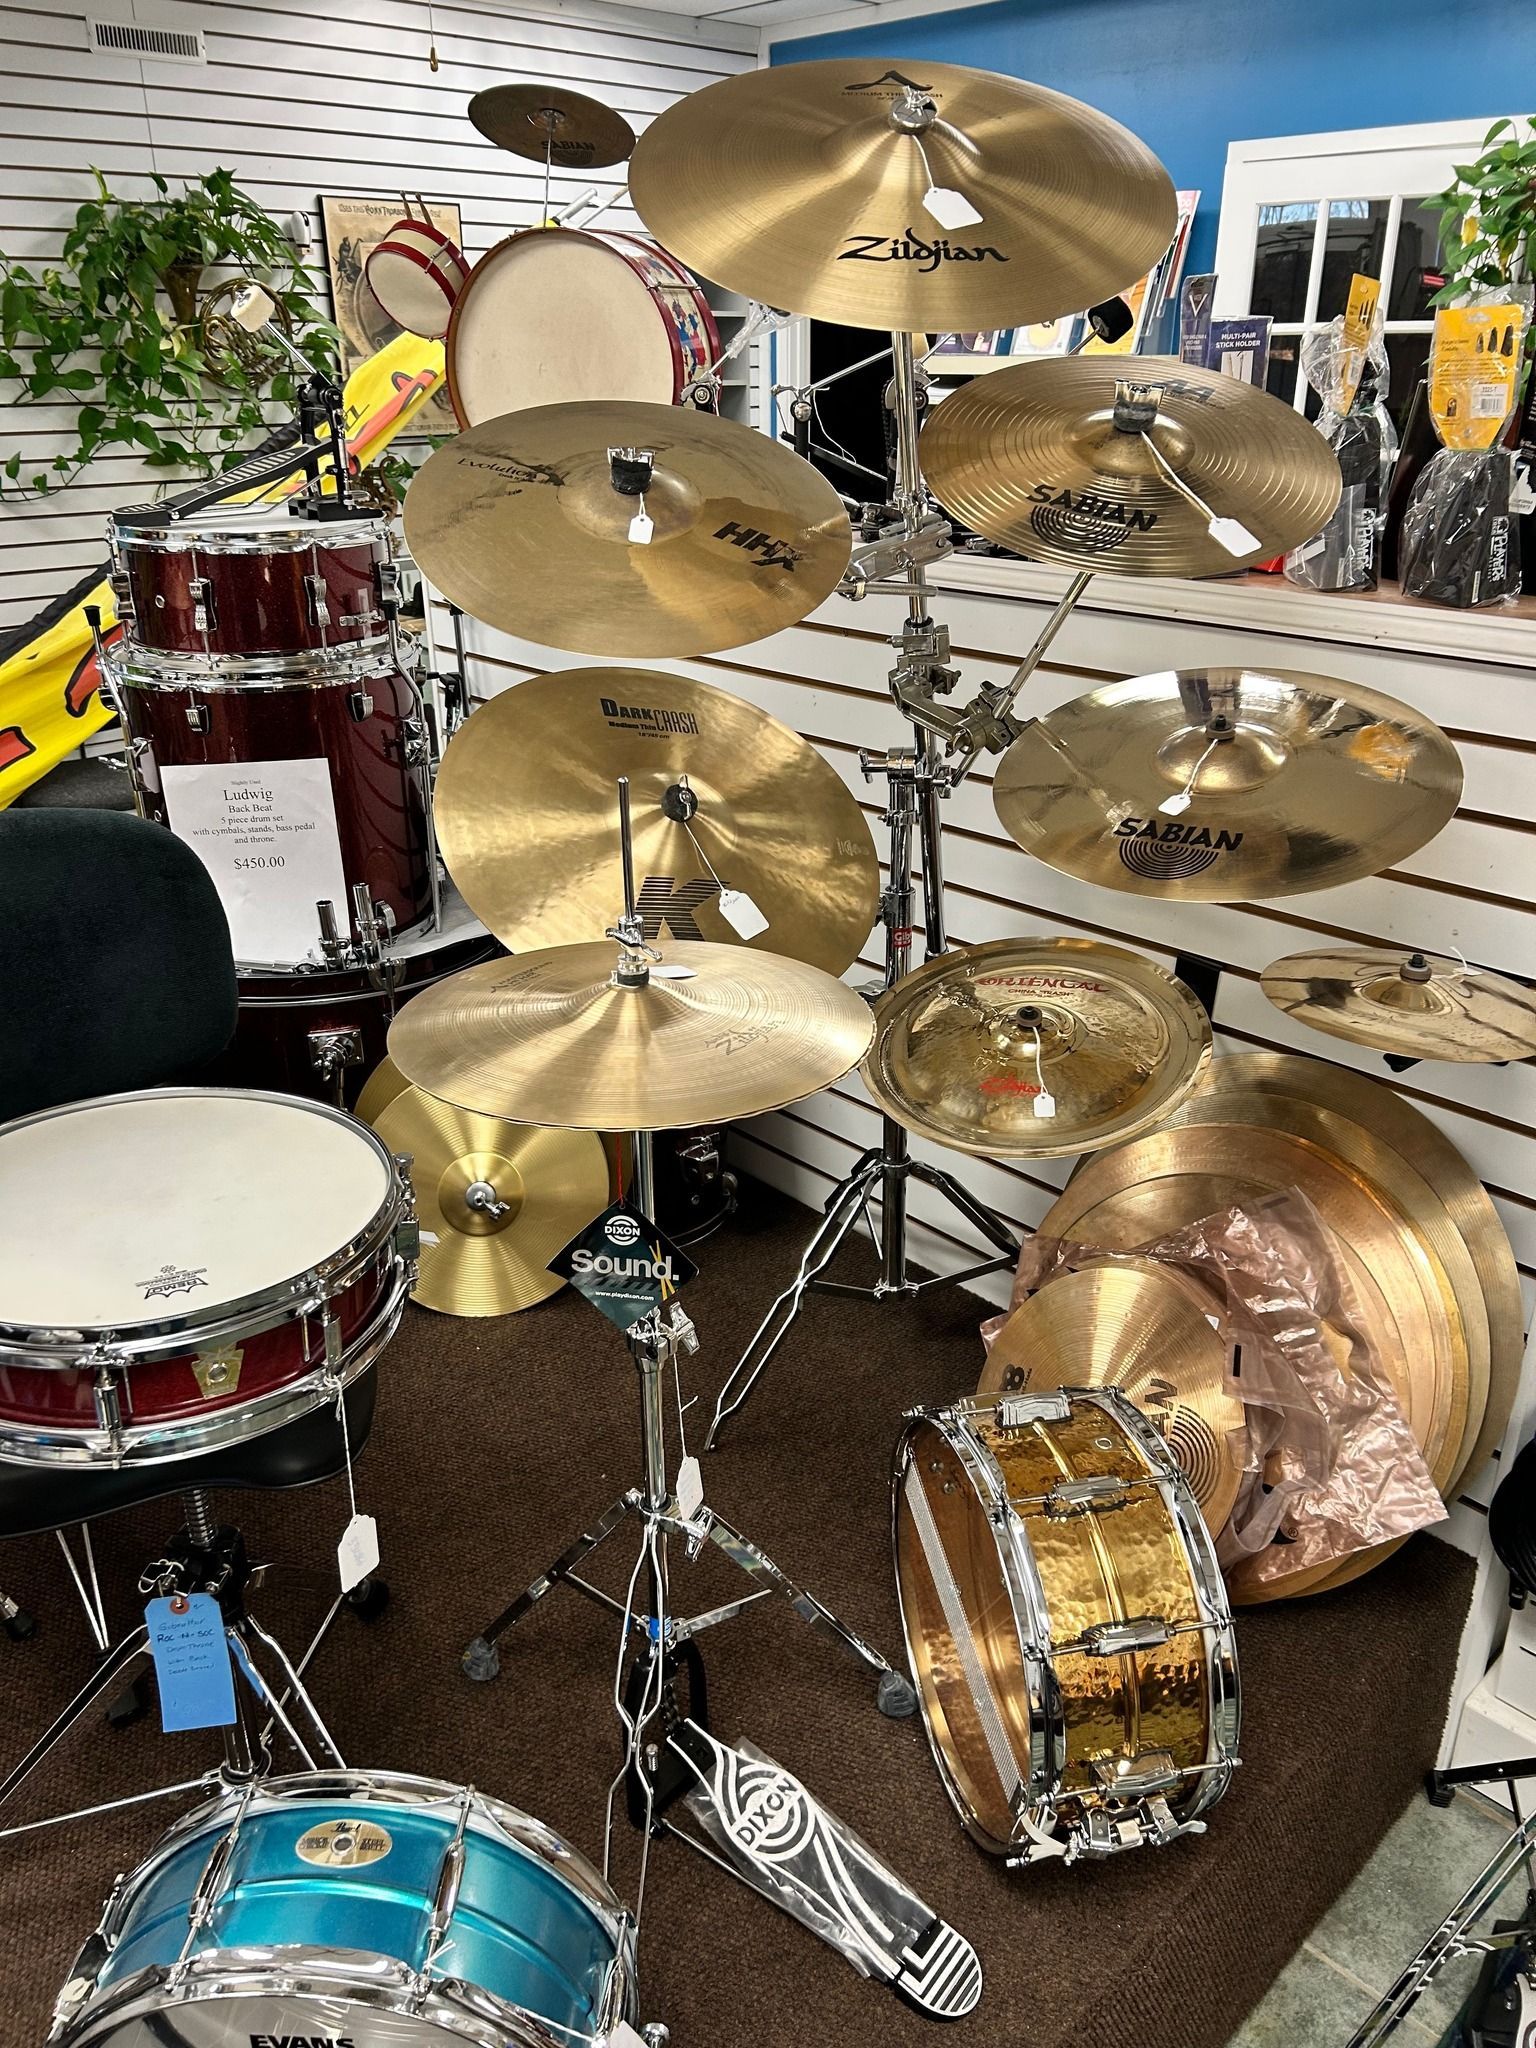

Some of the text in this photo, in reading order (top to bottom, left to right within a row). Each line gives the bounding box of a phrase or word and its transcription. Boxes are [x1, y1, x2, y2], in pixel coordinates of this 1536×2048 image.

[837, 227, 1011, 273] Zildjian
[1221, 331, 1257, 341] MULTI-PAIR
[1215, 341, 1234, 349] STICK
[1235, 339, 1261, 348] HOLDER
[456, 457, 538, 480] Evolution
[1026, 484, 1158, 532] SABIAN
[653, 709, 699, 735] CRASH
[223, 788, 274, 802] Ludwig
[228, 803, 273, 813] Back Beat
[221, 816, 226, 824] 5
[228, 816, 249, 825] piece
[250, 815, 271, 823] drum
[192, 822, 316, 837] with cymbals, stands, bass pedal
[1113, 817, 1244, 851] SABIAN
[234, 836, 249, 844] and
[233, 856, 285, 870] $450.00
[604, 1225, 641, 1236] DIXON
[571, 1249, 680, 1281] Sound.
[152, 1279, 197, 1293] REMO
[736, 1777, 798, 1847] DIXON
